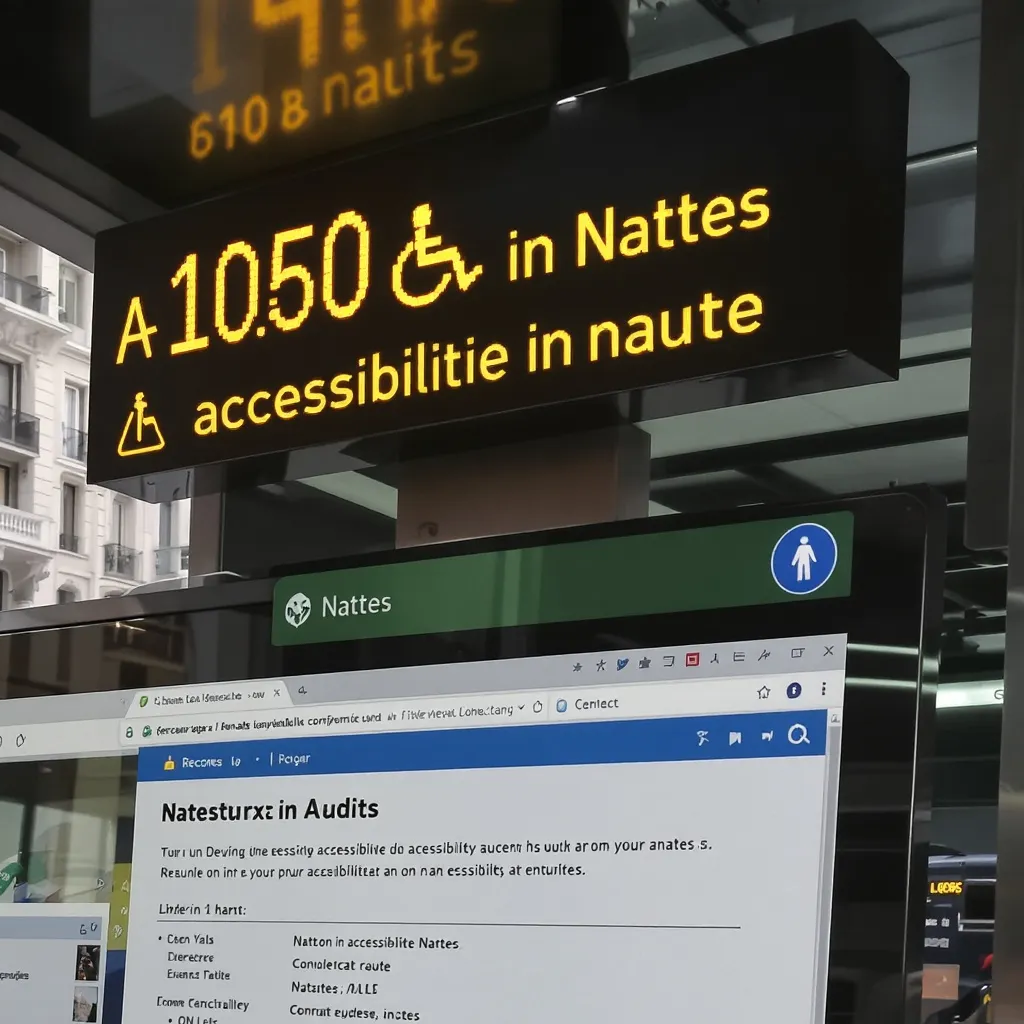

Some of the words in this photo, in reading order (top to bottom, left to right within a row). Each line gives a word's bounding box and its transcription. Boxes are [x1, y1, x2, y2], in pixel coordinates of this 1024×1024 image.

[116, 296, 158, 364] A
[508, 229, 553, 282] in
[576, 186, 770, 267] Nattes
[194, 337, 507, 436] accessibilitie
[527, 323, 571, 372] in
[590, 292, 764, 361] naute
[322, 594, 392, 618] Nattes
[279, 800, 297, 820] in
[304, 798, 379, 820] Audits
[615, 841, 645, 854] your
[207, 869, 219, 878] on
[250, 869, 274, 880] your
[384, 868, 397, 876] an
[402, 868, 415, 876] on
[335, 936, 344, 947] in
